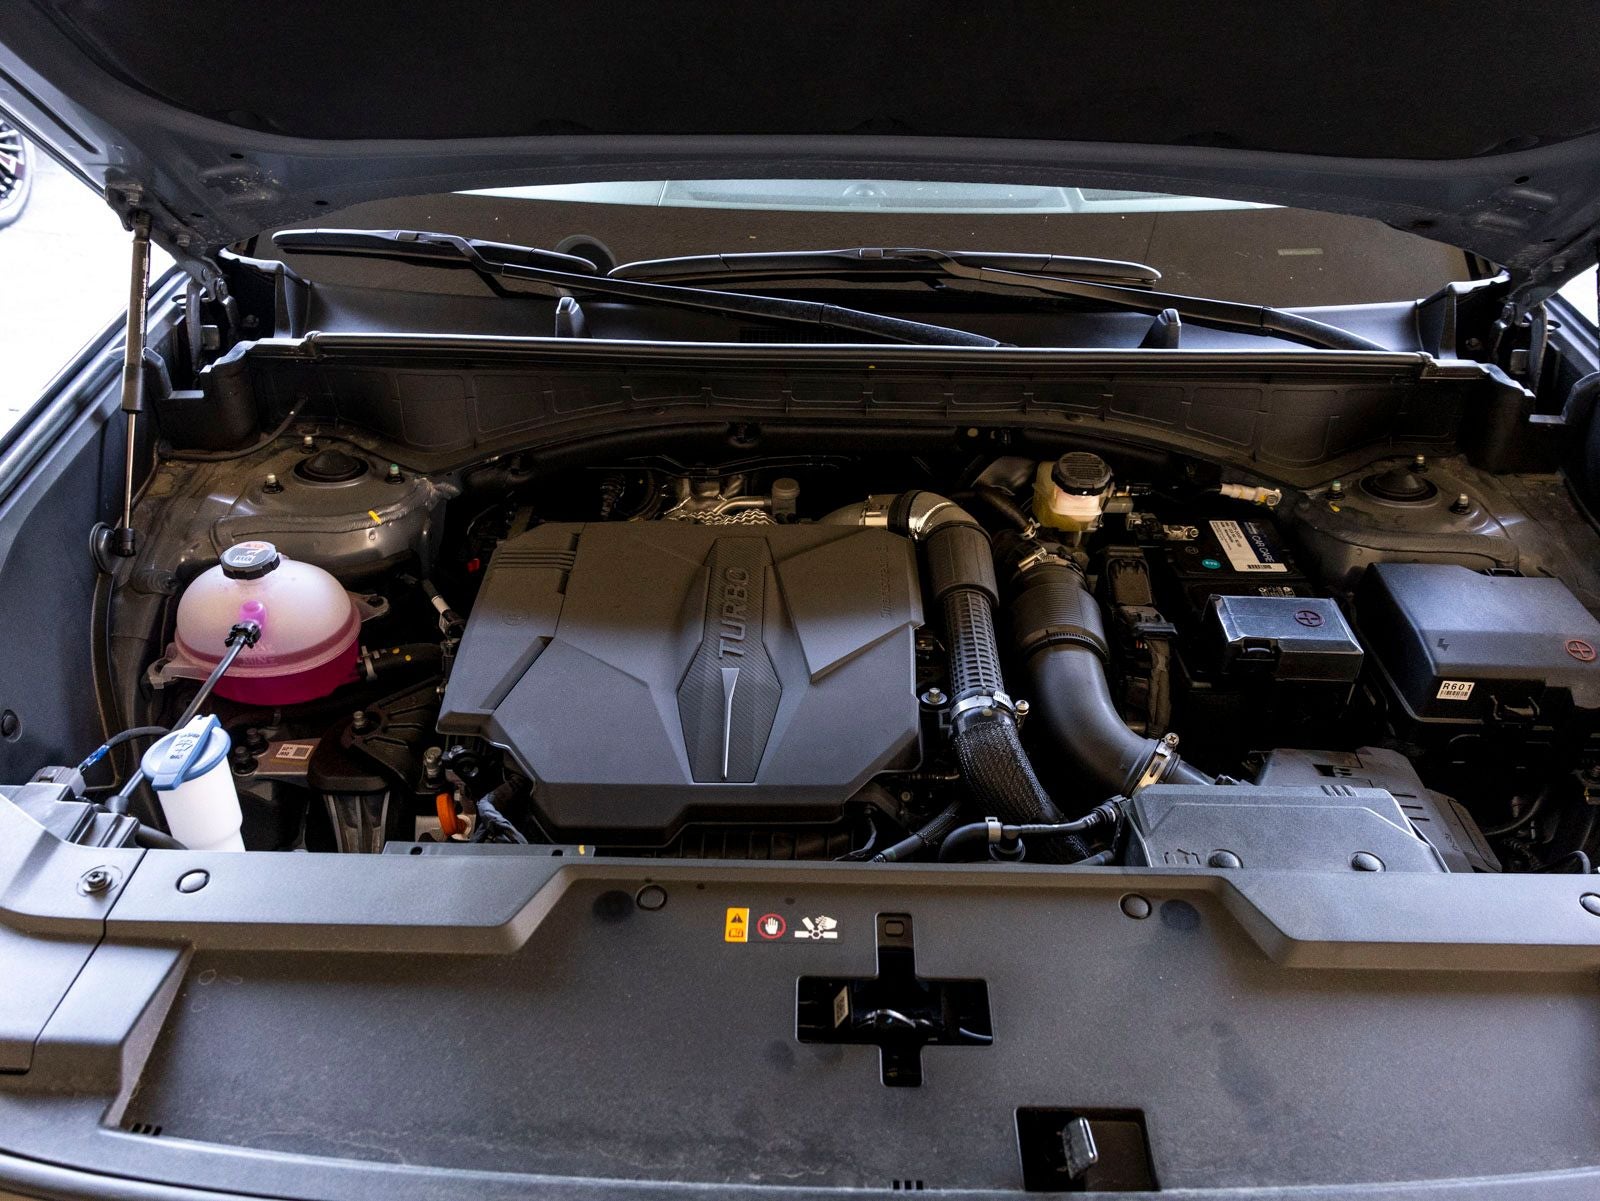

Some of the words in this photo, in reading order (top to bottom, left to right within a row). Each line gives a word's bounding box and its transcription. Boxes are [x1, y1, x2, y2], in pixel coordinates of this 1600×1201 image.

[1251, 535, 1266, 547] CAR
[719, 566, 749, 659] TURBO
[1443, 683, 1471, 691] R601
